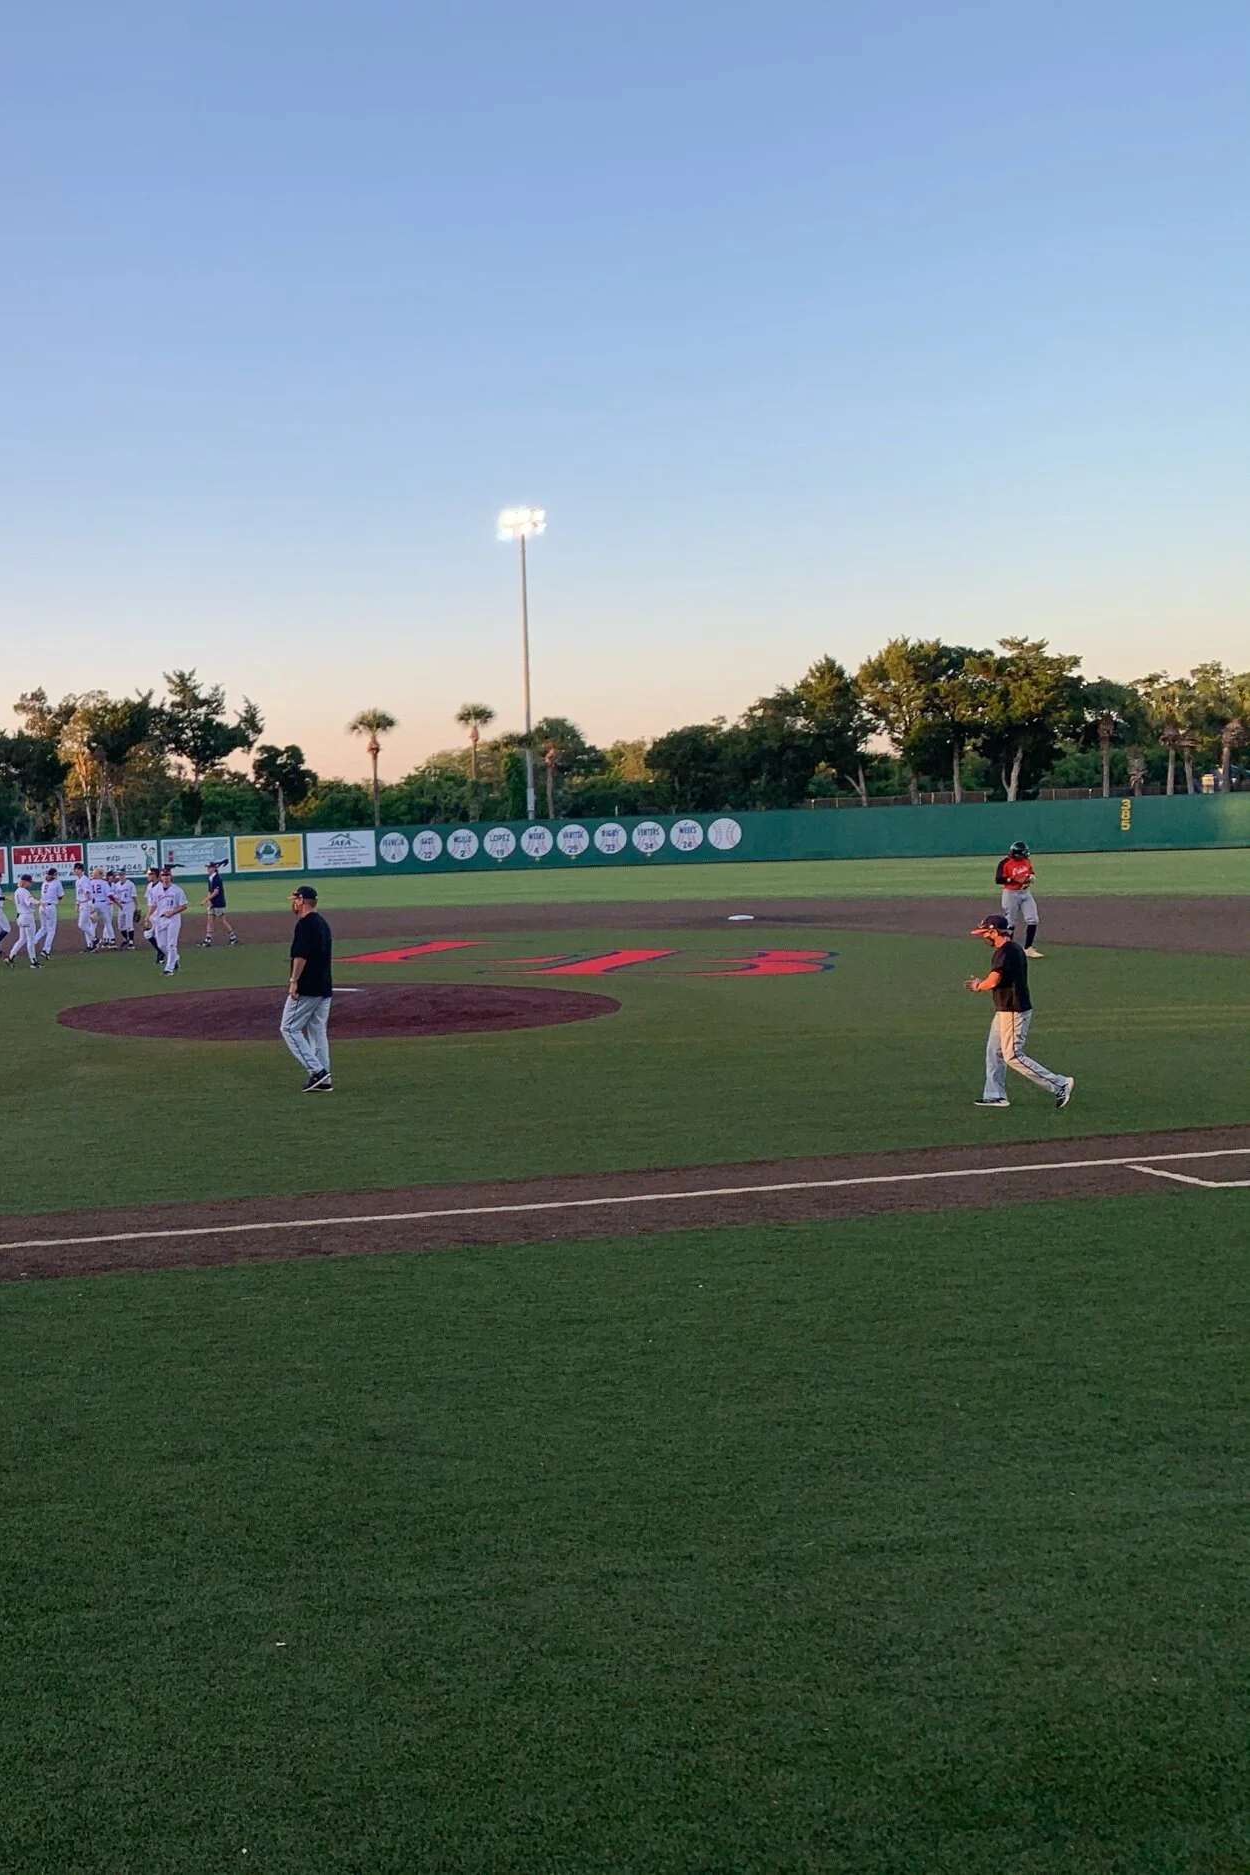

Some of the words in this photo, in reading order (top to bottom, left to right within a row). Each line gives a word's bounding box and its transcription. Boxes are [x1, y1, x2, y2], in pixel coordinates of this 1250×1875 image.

[1121, 799, 1131, 831] 385
[490, 833, 510, 842] LOPEZ
[29, 846, 67, 855] VENUS
[21, 853, 76, 863] PIZZERIA
[92, 884, 102, 895] 12
